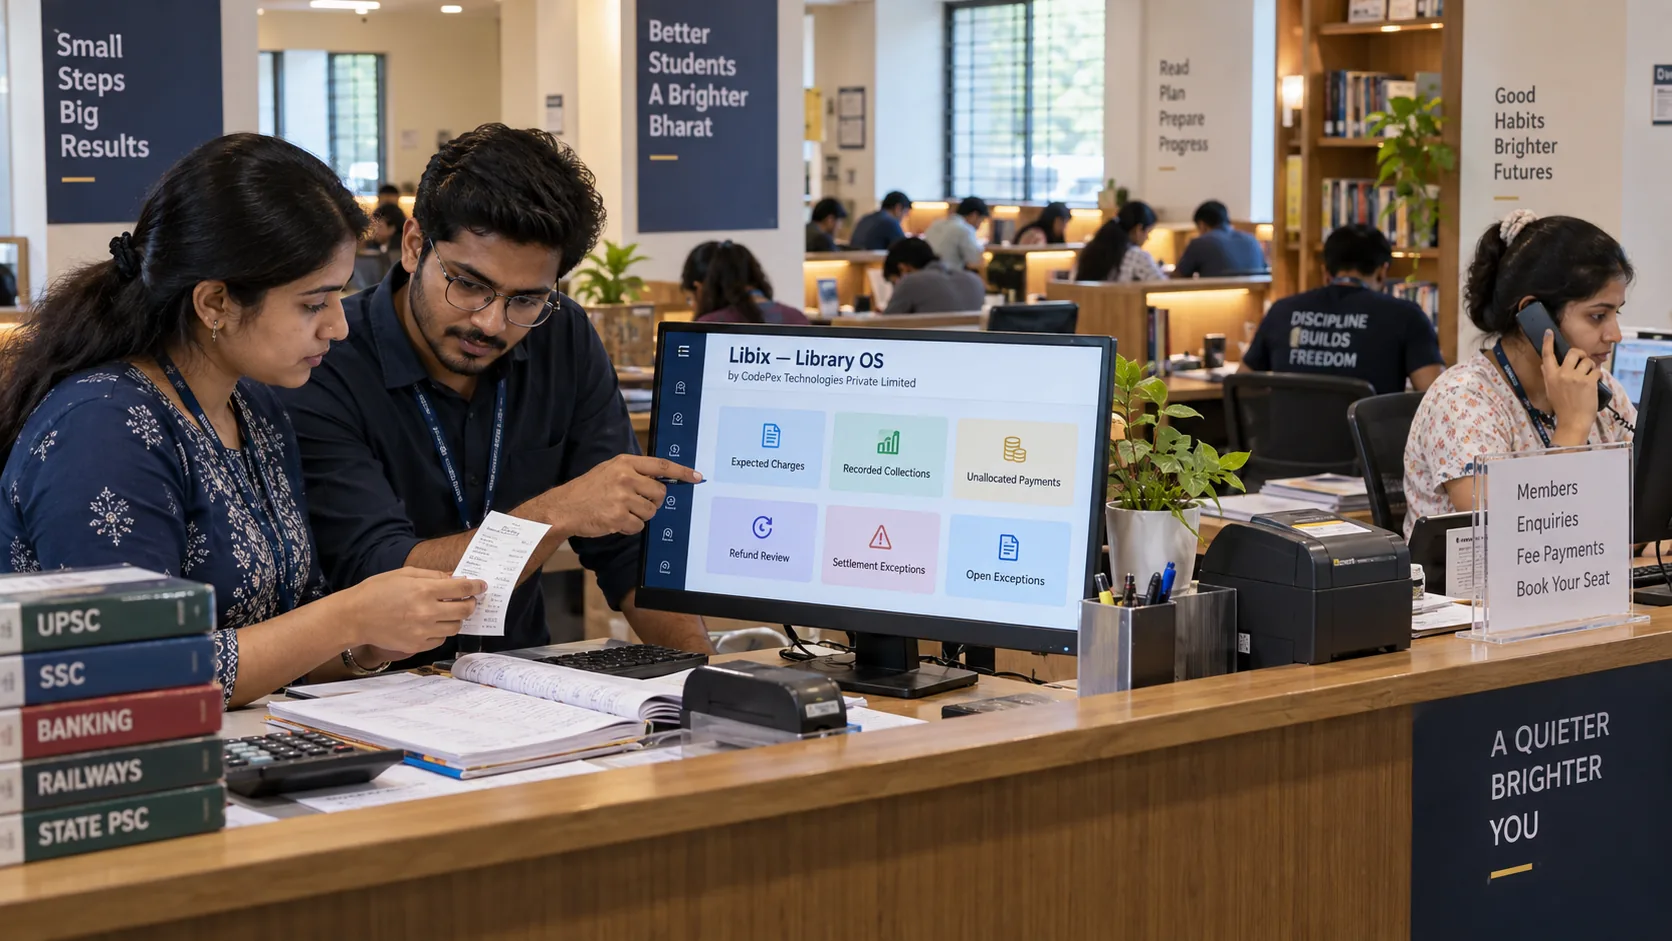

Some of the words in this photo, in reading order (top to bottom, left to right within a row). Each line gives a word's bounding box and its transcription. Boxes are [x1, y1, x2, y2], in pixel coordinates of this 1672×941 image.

[650, 20, 710, 44] Better
[56, 31, 123, 58] Small
[649, 51, 736, 76] Students
[1160, 58, 1189, 76] Read
[59, 67, 125, 97] Steps
[1160, 84, 1185, 101] Plan
[649, 83, 663, 105] A
[666, 83, 749, 115] Brighter
[1495, 85, 1535, 104] Good
[60, 100, 98, 130] Big
[650, 114, 713, 137] Bharat
[1159, 110, 1205, 130] Prepare
[1495, 112, 1544, 129] Habits
[61, 133, 149, 157] Results
[1159, 136, 1208, 156] Progress
[1495, 137, 1558, 159] Brighter
[1495, 163, 1552, 180] Futures
[1291, 311, 1368, 331] DISCIPLINE
[1298, 327, 1350, 350] BUILDS
[730, 347, 770, 364] Libix
[796, 350, 855, 372] Library
[860, 352, 883, 368] OS
[1289, 347, 1357, 367] FREEDOM
[728, 370, 739, 382] by
[741, 371, 781, 382] CodePex
[784, 373, 843, 386] Technologies
[846, 376, 878, 386] Private
[881, 377, 916, 388] Limited
[732, 457, 769, 468] Expected
[771, 459, 804, 472] Charges
[844, 464, 881, 475] Recorded
[884, 466, 930, 478] Collections
[967, 472, 1017, 484] Unallocated
[1019, 476, 1060, 487] Payments
[1518, 480, 1578, 500] Members
[1518, 511, 1578, 534] Enquiries
[730, 548, 758, 559] Refund
[761, 551, 790, 562] Review
[1518, 548, 1540, 565] Fee
[1544, 541, 1604, 564] Payments
[833, 558, 878, 570] Settlement
[880, 562, 925, 574] Exceptions
[966, 570, 991, 581] Open
[994, 572, 1045, 585] Exceptions
[1517, 577, 1548, 597] Book
[1552, 576, 1580, 592] Your
[1584, 571, 1610, 587] Seat
[38, 608, 100, 636] UPSC
[40, 662, 85, 688] SSC
[38, 707, 132, 742] BANKING
[1491, 730, 1507, 757] A
[1515, 712, 1609, 754] QUIETER
[38, 758, 142, 795] RAILWAYS
[1491, 753, 1602, 800] BRIGHTER
[39, 814, 102, 846] STATE
[108, 807, 149, 834] PSC
[1490, 811, 1538, 845] YOU
